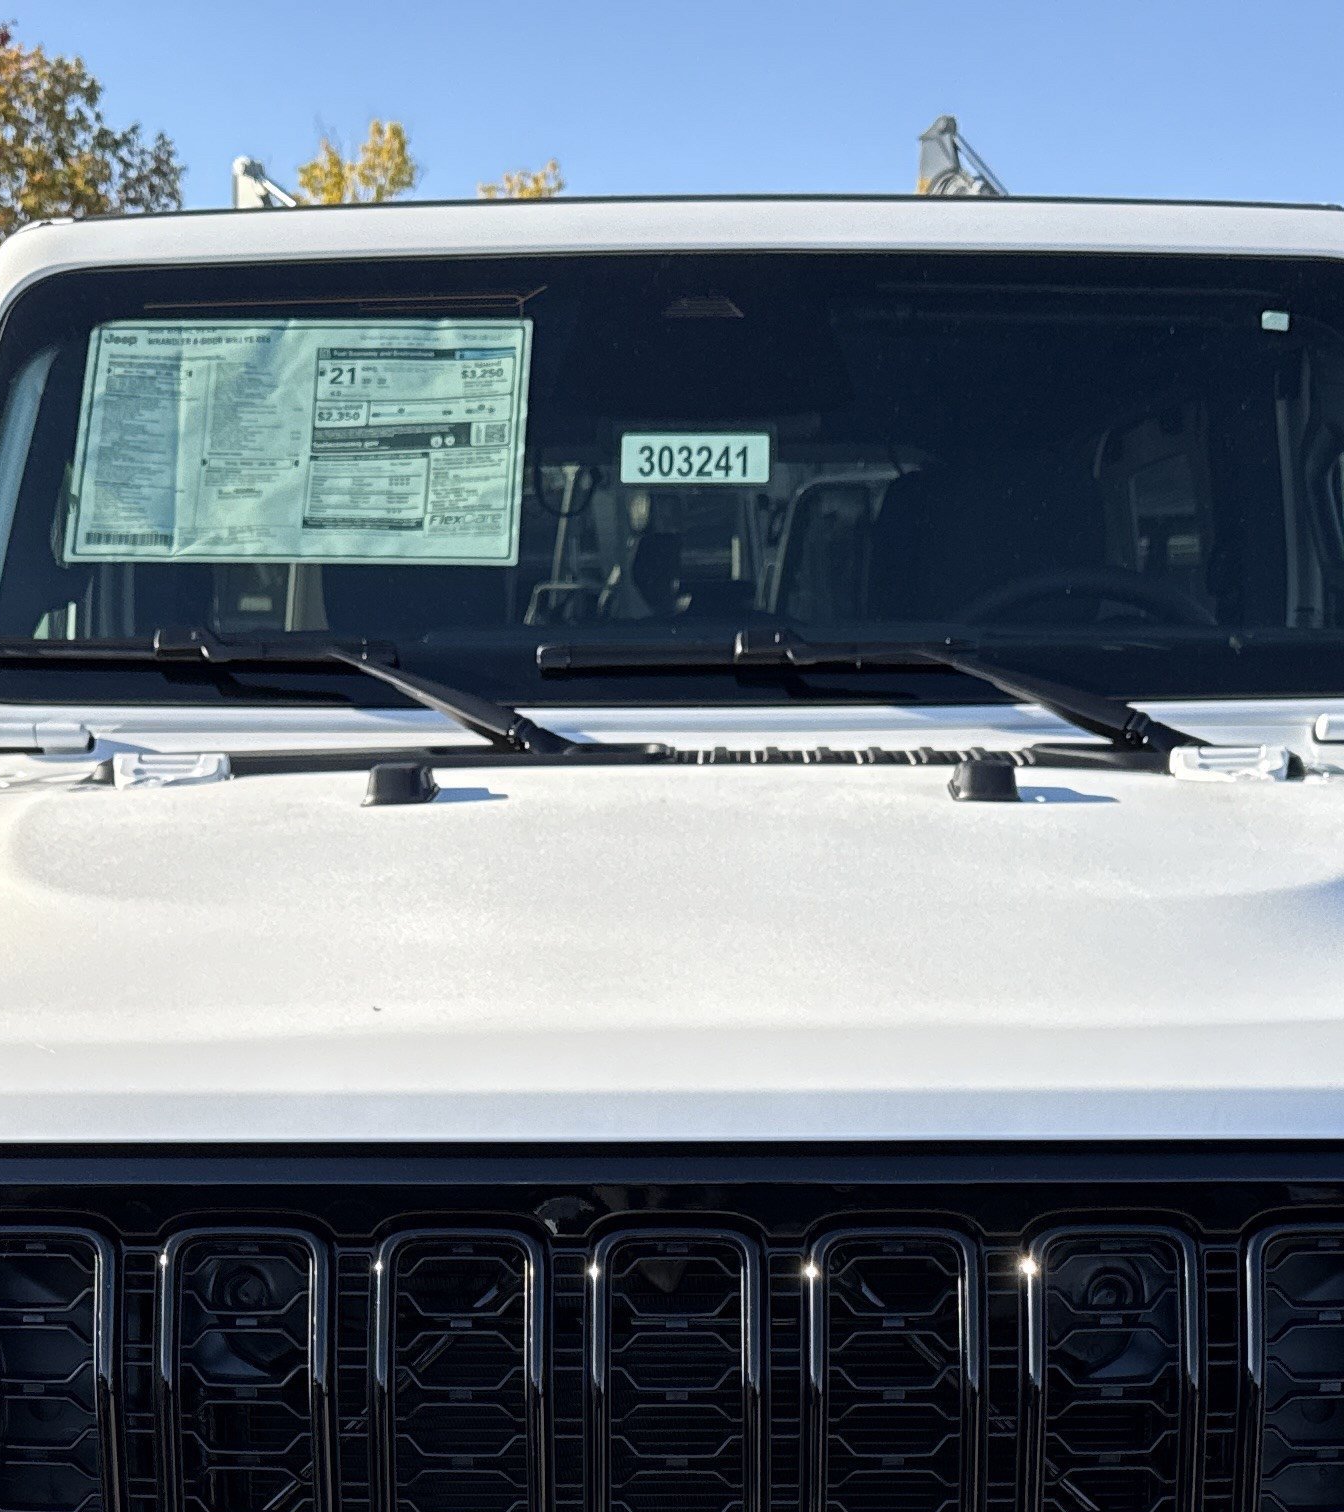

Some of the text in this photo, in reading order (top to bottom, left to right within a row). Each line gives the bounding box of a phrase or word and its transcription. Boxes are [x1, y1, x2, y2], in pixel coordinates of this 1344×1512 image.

[104, 334, 138, 346] Jeep
[330, 366, 356, 385] 21
[461, 367, 504, 380] $3,250
[317, 411, 361, 423] $2,350
[637, 445, 749, 477] 303241
